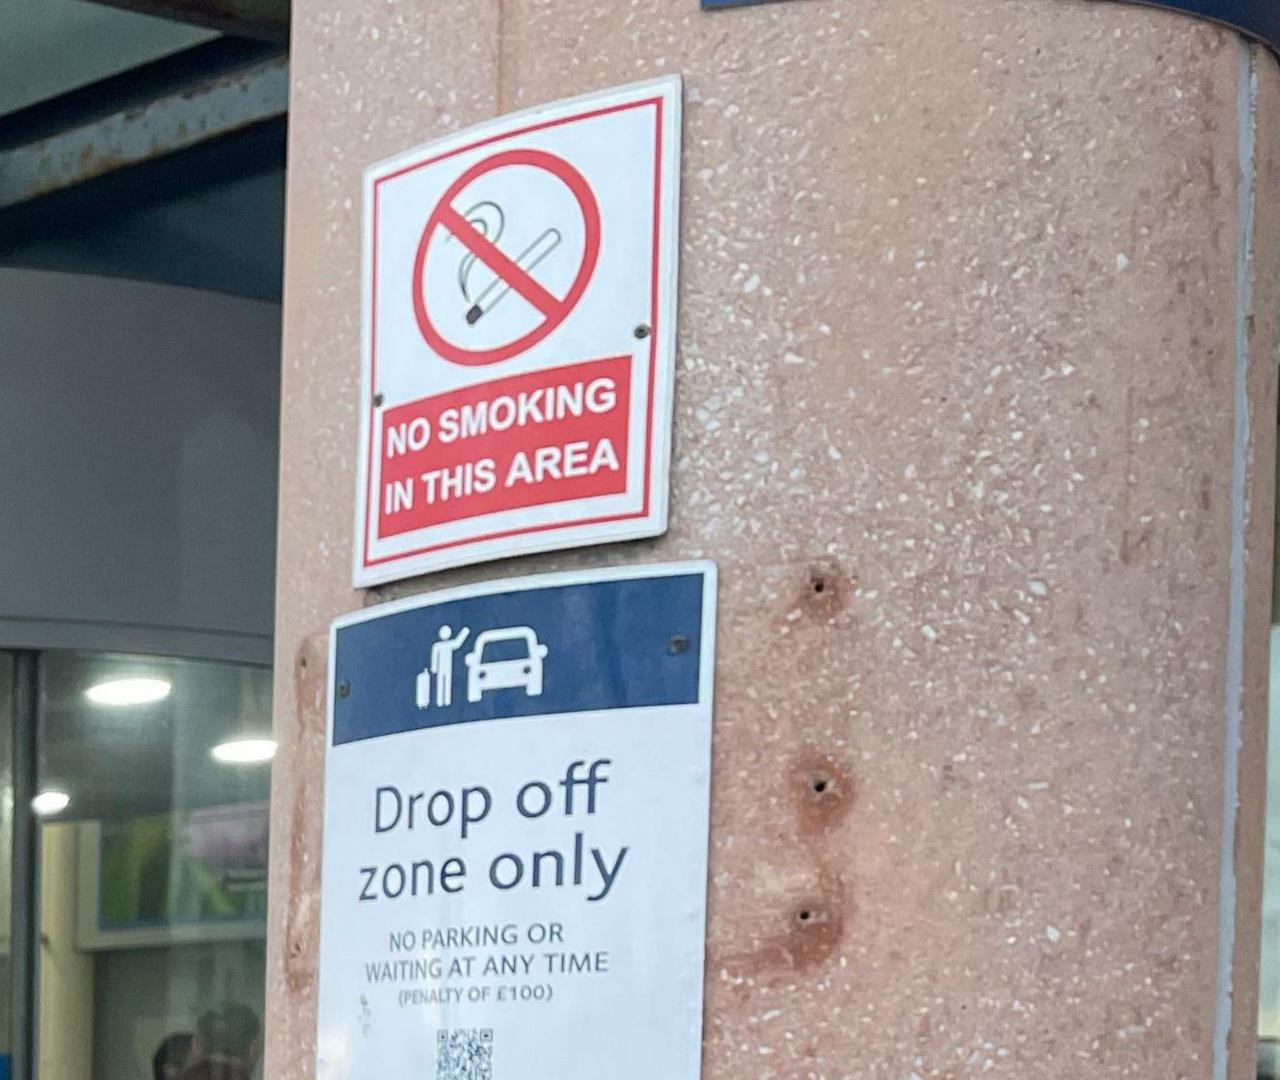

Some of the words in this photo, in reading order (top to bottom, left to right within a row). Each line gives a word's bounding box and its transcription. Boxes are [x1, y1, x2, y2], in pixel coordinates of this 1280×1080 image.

[386, 416, 431, 459] NO
[437, 377, 617, 444] SMOKING
[384, 477, 414, 515] IN
[421, 458, 496, 505] THIS
[504, 438, 620, 488] AREA
[374, 785, 492, 839] Drop
[516, 758, 611, 818] off
[359, 856, 466, 901] zone
[489, 832, 629, 901] only
[365, 957, 441, 982] WAITING
[447, 956, 476, 978] AT
[482, 953, 535, 976] ANY
[544, 951, 609, 974] TIME
[389, 930, 416, 951] NO
[422, 924, 518, 951] PARKING
[527, 922, 564, 944] OR
[398, 987, 464, 1008] (PENALTY
[468, 986, 490, 1002] OF
[497, 984, 553, 1001] £100)
